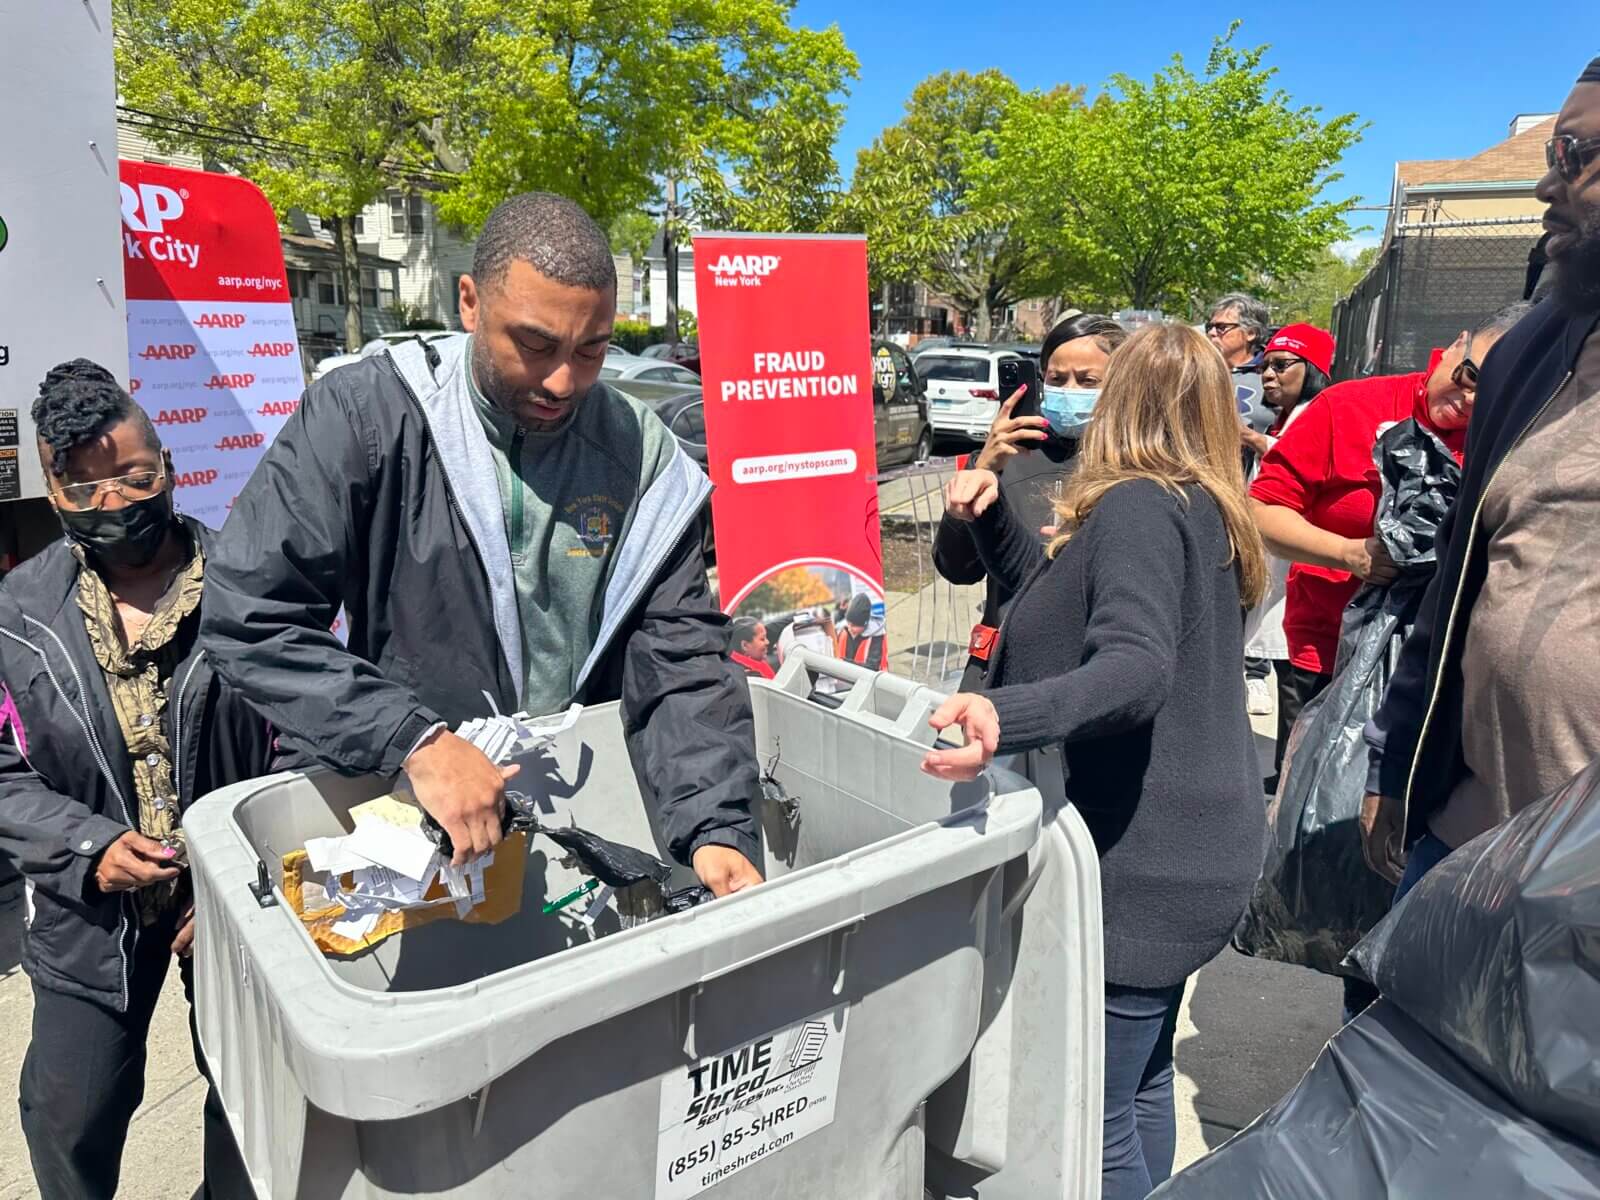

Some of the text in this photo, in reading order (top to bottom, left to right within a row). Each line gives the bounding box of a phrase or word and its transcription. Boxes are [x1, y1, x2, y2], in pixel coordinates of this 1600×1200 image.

[120, 182, 184, 233] RP
[149, 235, 200, 268] City
[707, 256, 778, 275] AARP
[218, 275, 283, 290] aarp.org/nyc
[715, 276, 761, 287] New York
[193, 313, 246, 328] AARP
[138, 344, 196, 360] AARP
[248, 343, 294, 357] AARP
[754, 351, 825, 374] FRAUD
[204, 373, 255, 390] AARP
[721, 375, 857, 401] PREVENTION
[152, 407, 207, 426] AARP
[214, 433, 264, 450] AARP
[743, 457, 848, 476] aarp.org/nystopscams
[687, 1036, 773, 1098] TIME
[683, 1067, 769, 1124] Shred
[668, 1096, 808, 1182] (855) 85-SHRED
[701, 1131, 794, 1186] timeshred.com
